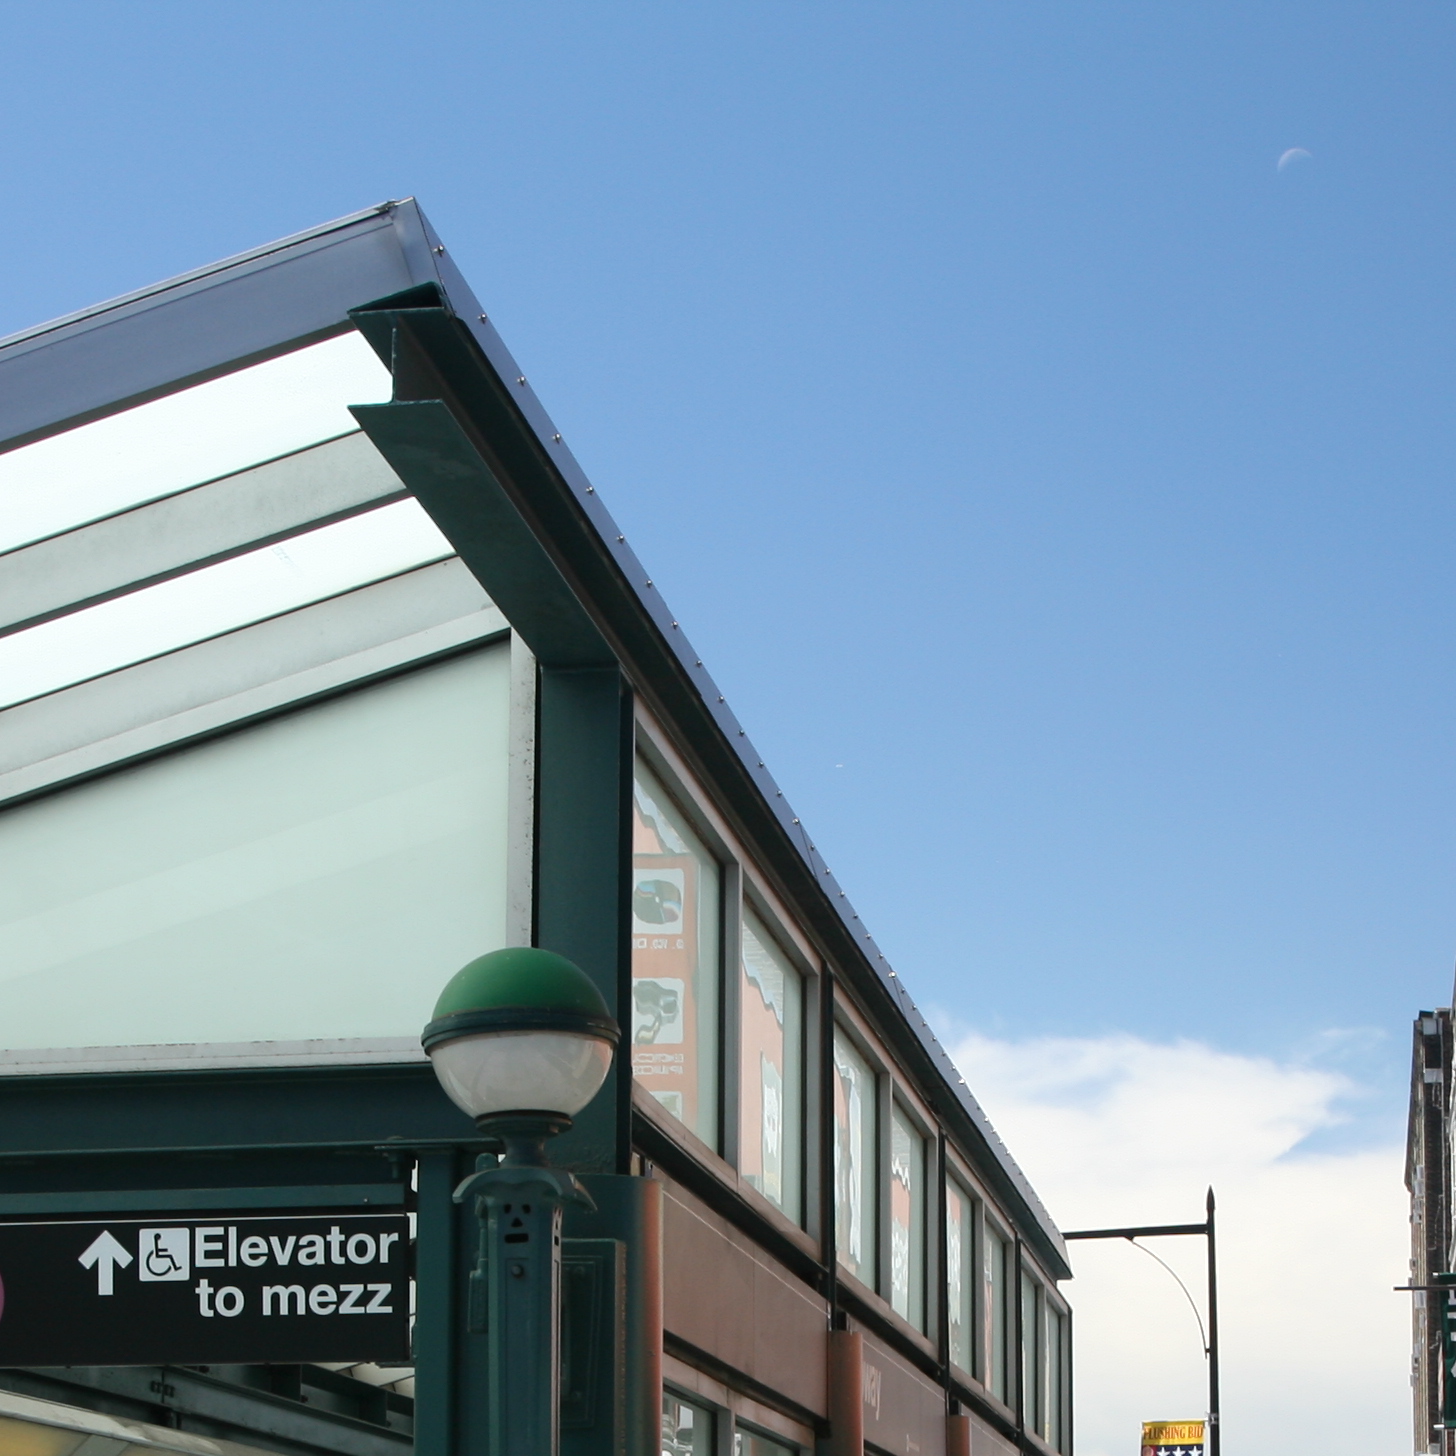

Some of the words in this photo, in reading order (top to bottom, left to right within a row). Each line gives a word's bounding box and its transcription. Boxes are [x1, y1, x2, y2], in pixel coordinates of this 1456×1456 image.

[193, 1224, 399, 1268] Elevator
[195, 1278, 239, 1318] to
[258, 1280, 394, 1317] mezz
[1143, 1424, 1186, 1440] FLUSHING
